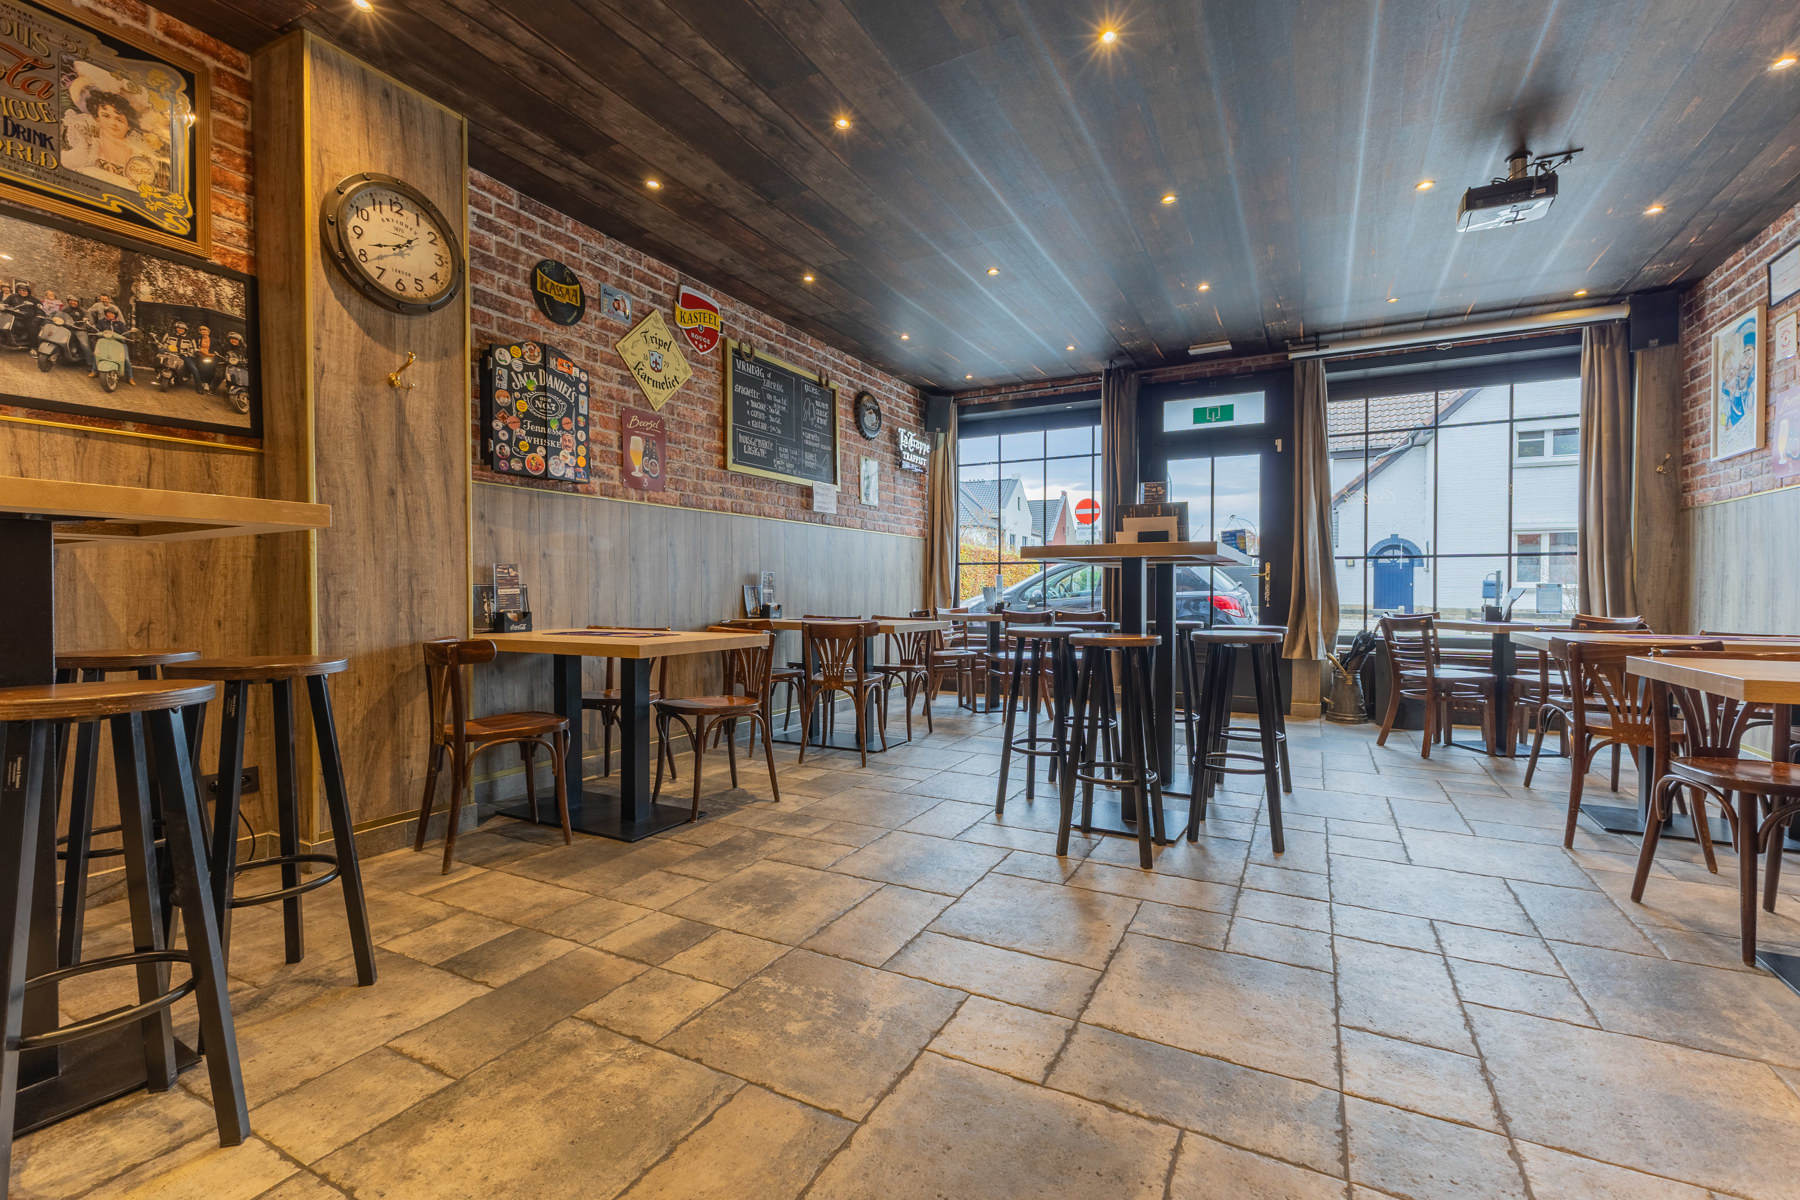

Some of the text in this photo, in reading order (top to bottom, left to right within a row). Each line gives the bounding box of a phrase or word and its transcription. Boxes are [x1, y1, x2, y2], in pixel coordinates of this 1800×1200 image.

[3, 115, 55, 151] DRINK
[355, 206, 369, 221] 10
[372, 198, 382, 214] 11
[389, 198, 404, 216] 12
[416, 213, 420, 227] 1
[352, 225, 364, 239] 9
[427, 231, 438, 246] 2
[358, 248, 368, 263] 8
[434, 253, 444, 267] 3
[375, 266, 386, 280] 7
[429, 272, 440, 284] 4
[395, 278, 406, 292] 6
[414, 278, 424, 292] 5
[680, 310, 719, 327] KASTEEL
[640, 328, 673, 352] Tripel
[633, 361, 680, 391] Karmeliet
[626, 415, 660, 430] Beersel
